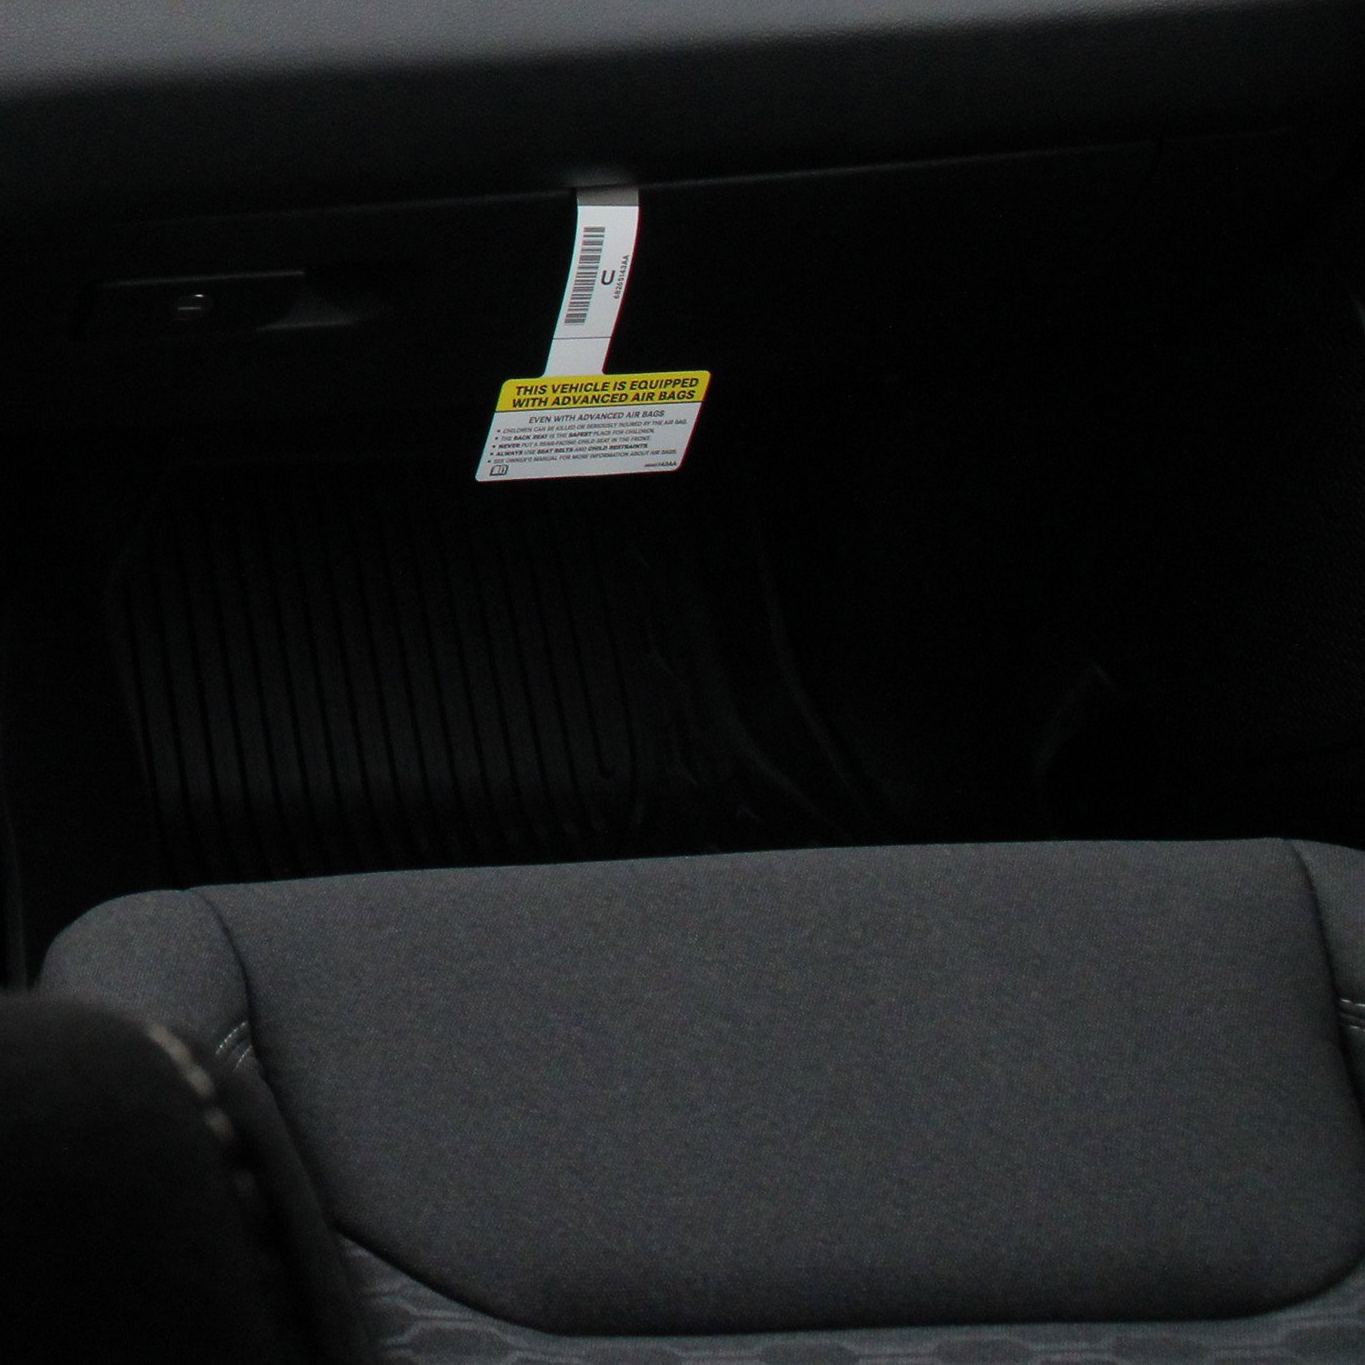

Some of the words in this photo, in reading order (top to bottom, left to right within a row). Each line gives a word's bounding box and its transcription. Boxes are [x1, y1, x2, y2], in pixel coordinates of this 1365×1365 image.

[601, 269, 615, 285] U
[516, 384, 548, 396] THIS
[551, 381, 610, 394] VEHICLE
[613, 381, 627, 391] IS
[629, 378, 699, 390] EQUIPPED
[512, 397, 548, 408] WITH
[551, 393, 628, 406] ADVANCED
[631, 392, 655, 402] AIR
[658, 390, 696, 400] BAGS
[529, 416, 551, 424] EVEN
[554, 415, 576, 423] WITH
[577, 412, 624, 421] ADVANCED
